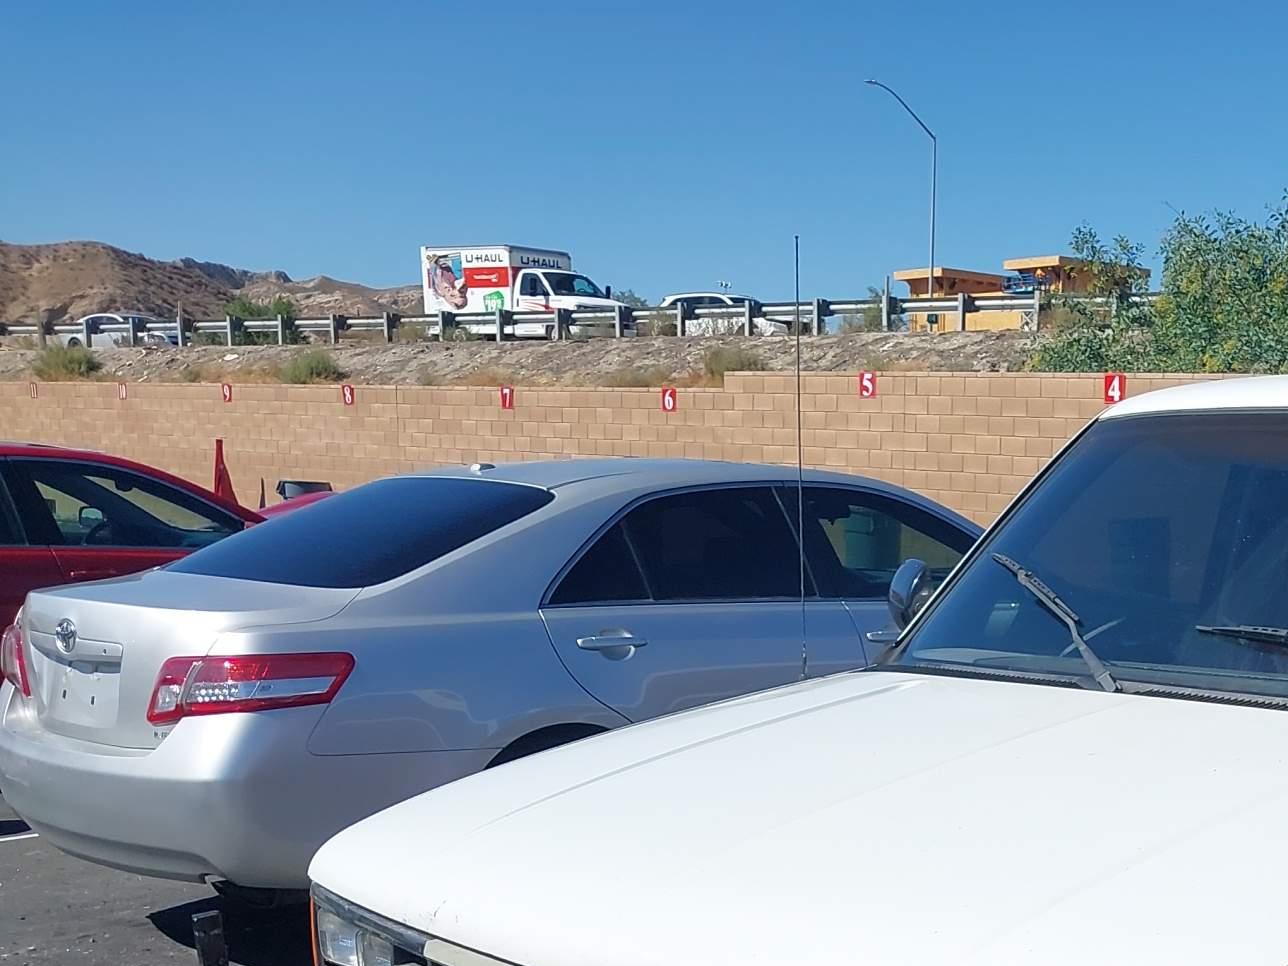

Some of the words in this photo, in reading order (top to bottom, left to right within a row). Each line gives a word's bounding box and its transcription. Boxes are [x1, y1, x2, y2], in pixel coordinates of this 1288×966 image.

[223, 384, 231, 401] 9
[862, 372, 874, 396] 5
[1107, 375, 1120, 402] 4
[343, 385, 352, 404] 8
[502, 388, 511, 408] 7
[663, 389, 674, 410] 6
